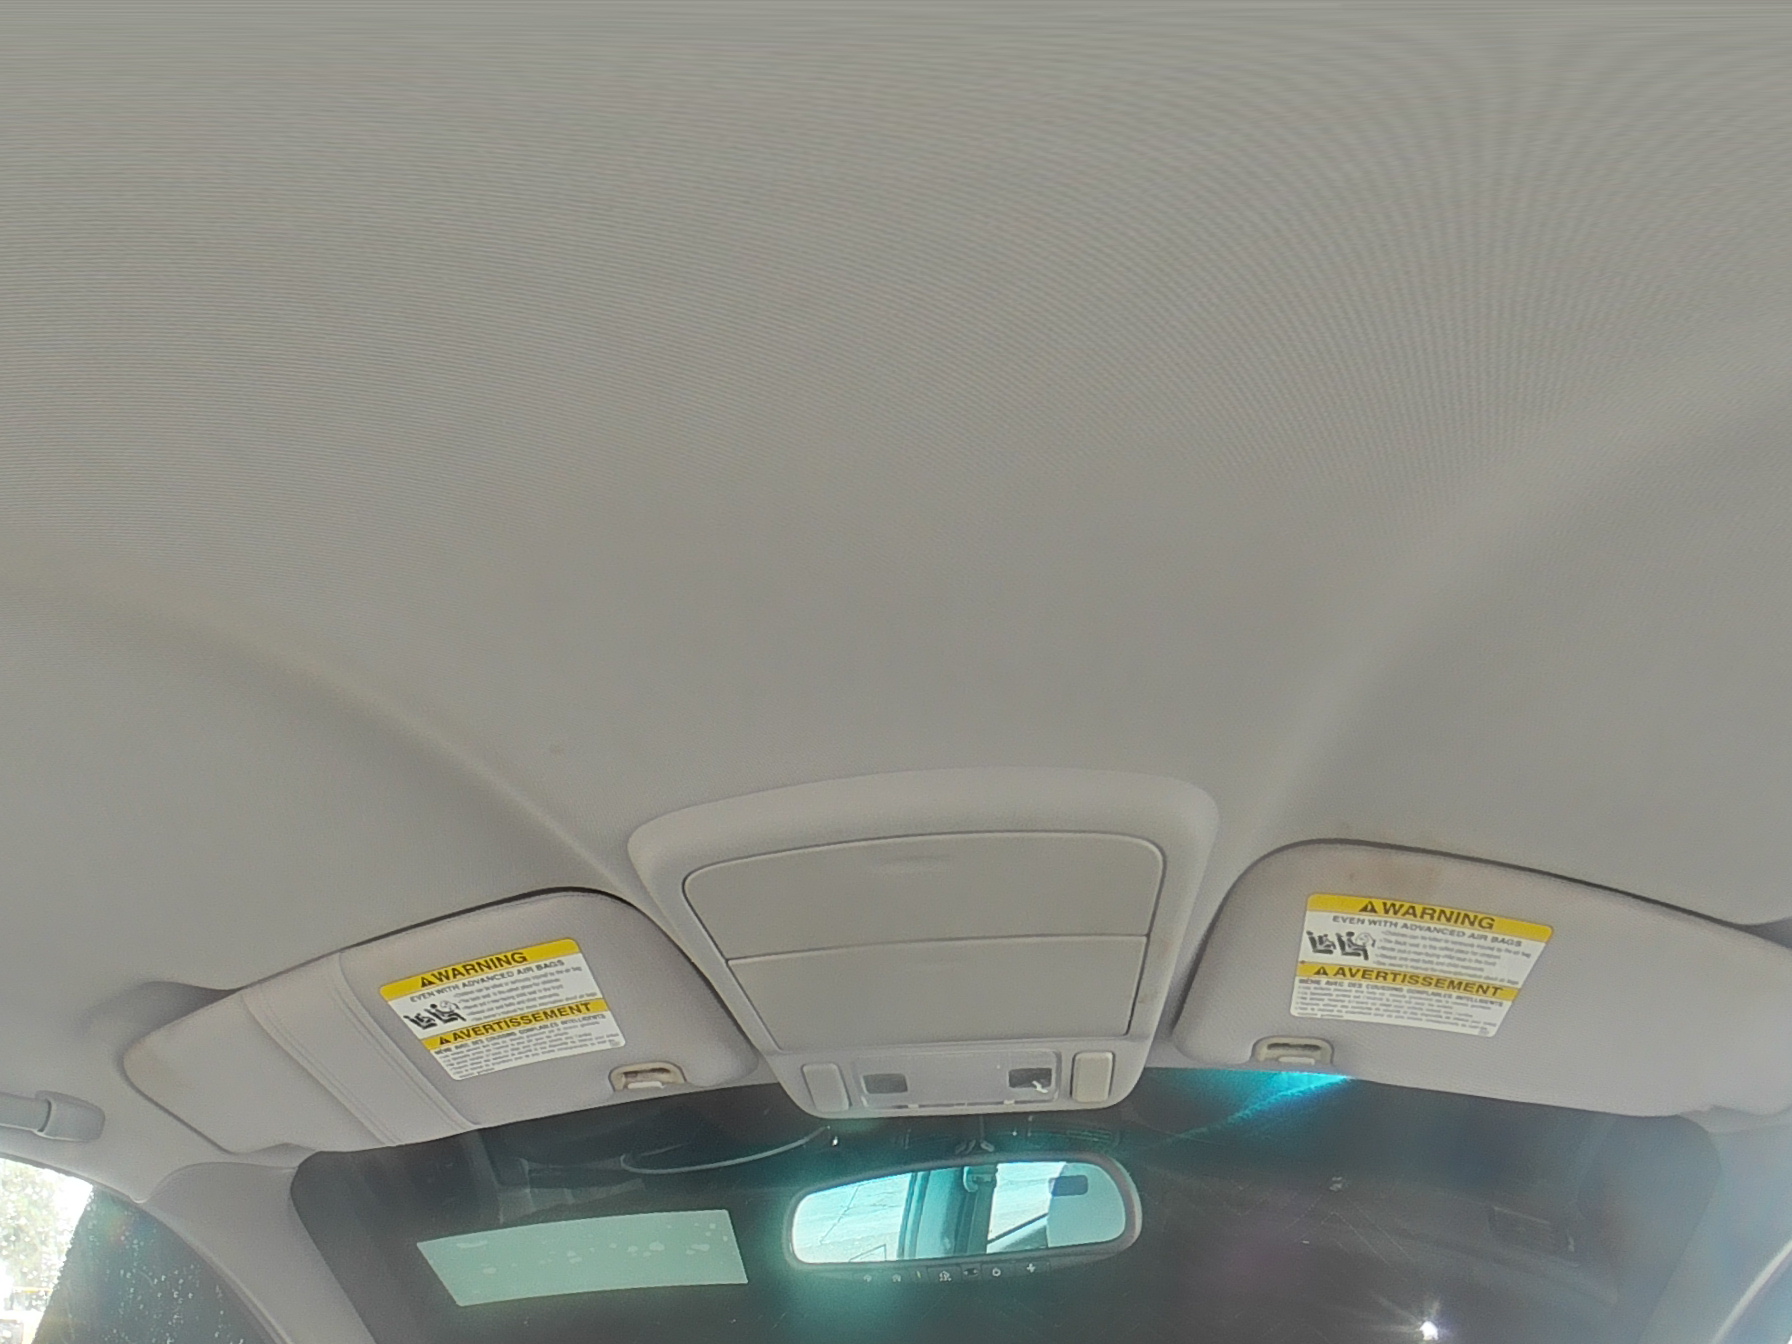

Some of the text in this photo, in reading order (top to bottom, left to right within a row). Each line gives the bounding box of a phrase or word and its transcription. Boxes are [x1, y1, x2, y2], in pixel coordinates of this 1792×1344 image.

[1382, 901, 1495, 930] WARNING
[1332, 915, 1522, 947] EVEN WITH ADVANCED AIR BAGS
[431, 952, 528, 983] WARNING
[462, 971, 514, 988] ADVANCED
[536, 960, 565, 971] BAGS
[1333, 967, 1503, 996] AVERTISSEMENT
[452, 1002, 591, 1041] AVERTISSEMENT
